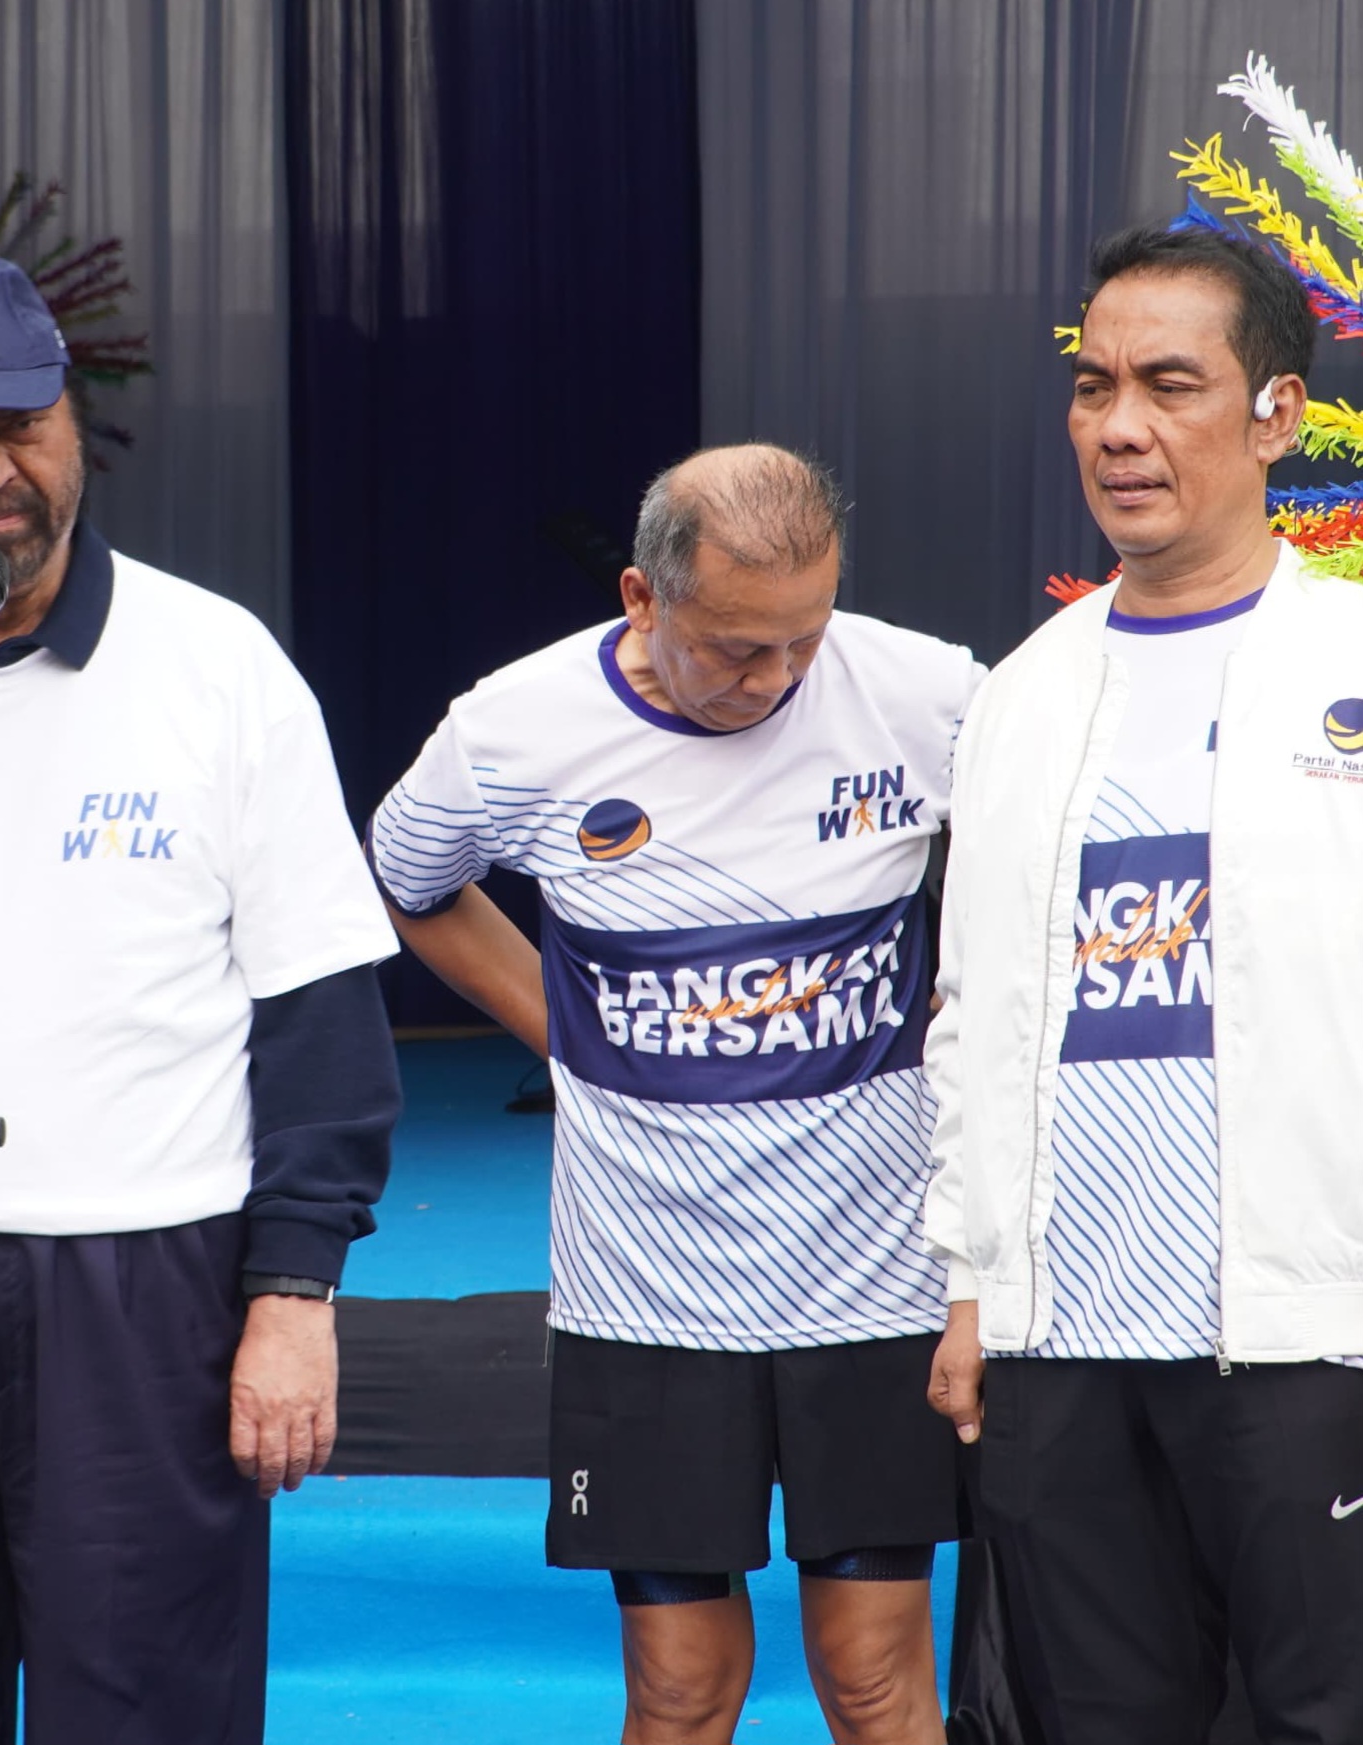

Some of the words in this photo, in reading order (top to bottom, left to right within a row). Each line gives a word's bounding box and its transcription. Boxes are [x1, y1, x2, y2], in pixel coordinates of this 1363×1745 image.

[1293, 753, 1336, 767] Partai
[831, 765, 904, 806] FUN
[79, 791, 159, 824] FUN
[588, 919, 904, 1011] LANGKAH
[597, 976, 904, 1057] BERSAMA
